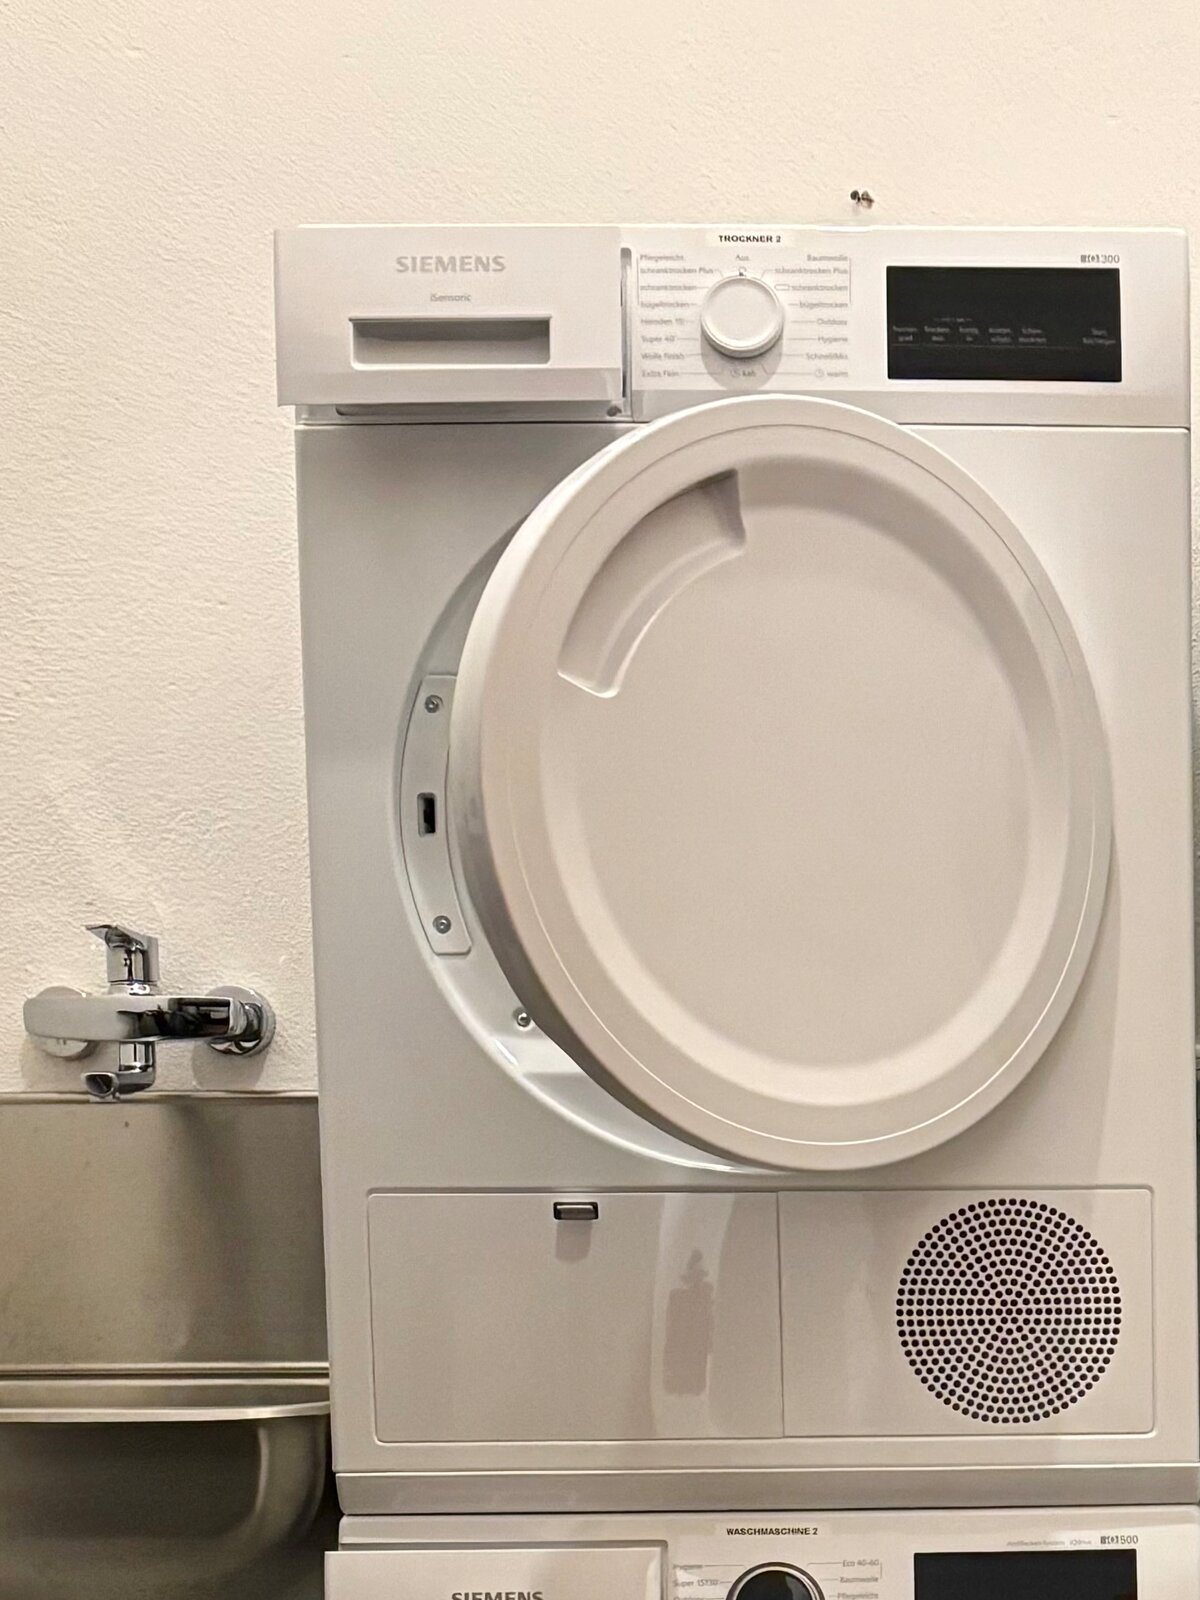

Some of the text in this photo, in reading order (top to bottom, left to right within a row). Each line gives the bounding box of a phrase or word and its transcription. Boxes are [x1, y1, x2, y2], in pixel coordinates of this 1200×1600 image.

[718, 235, 773, 243] TROCKNER
[395, 255, 506, 273] SIEMENS
[726, 1527, 810, 1536] WASCHMASCHINE
